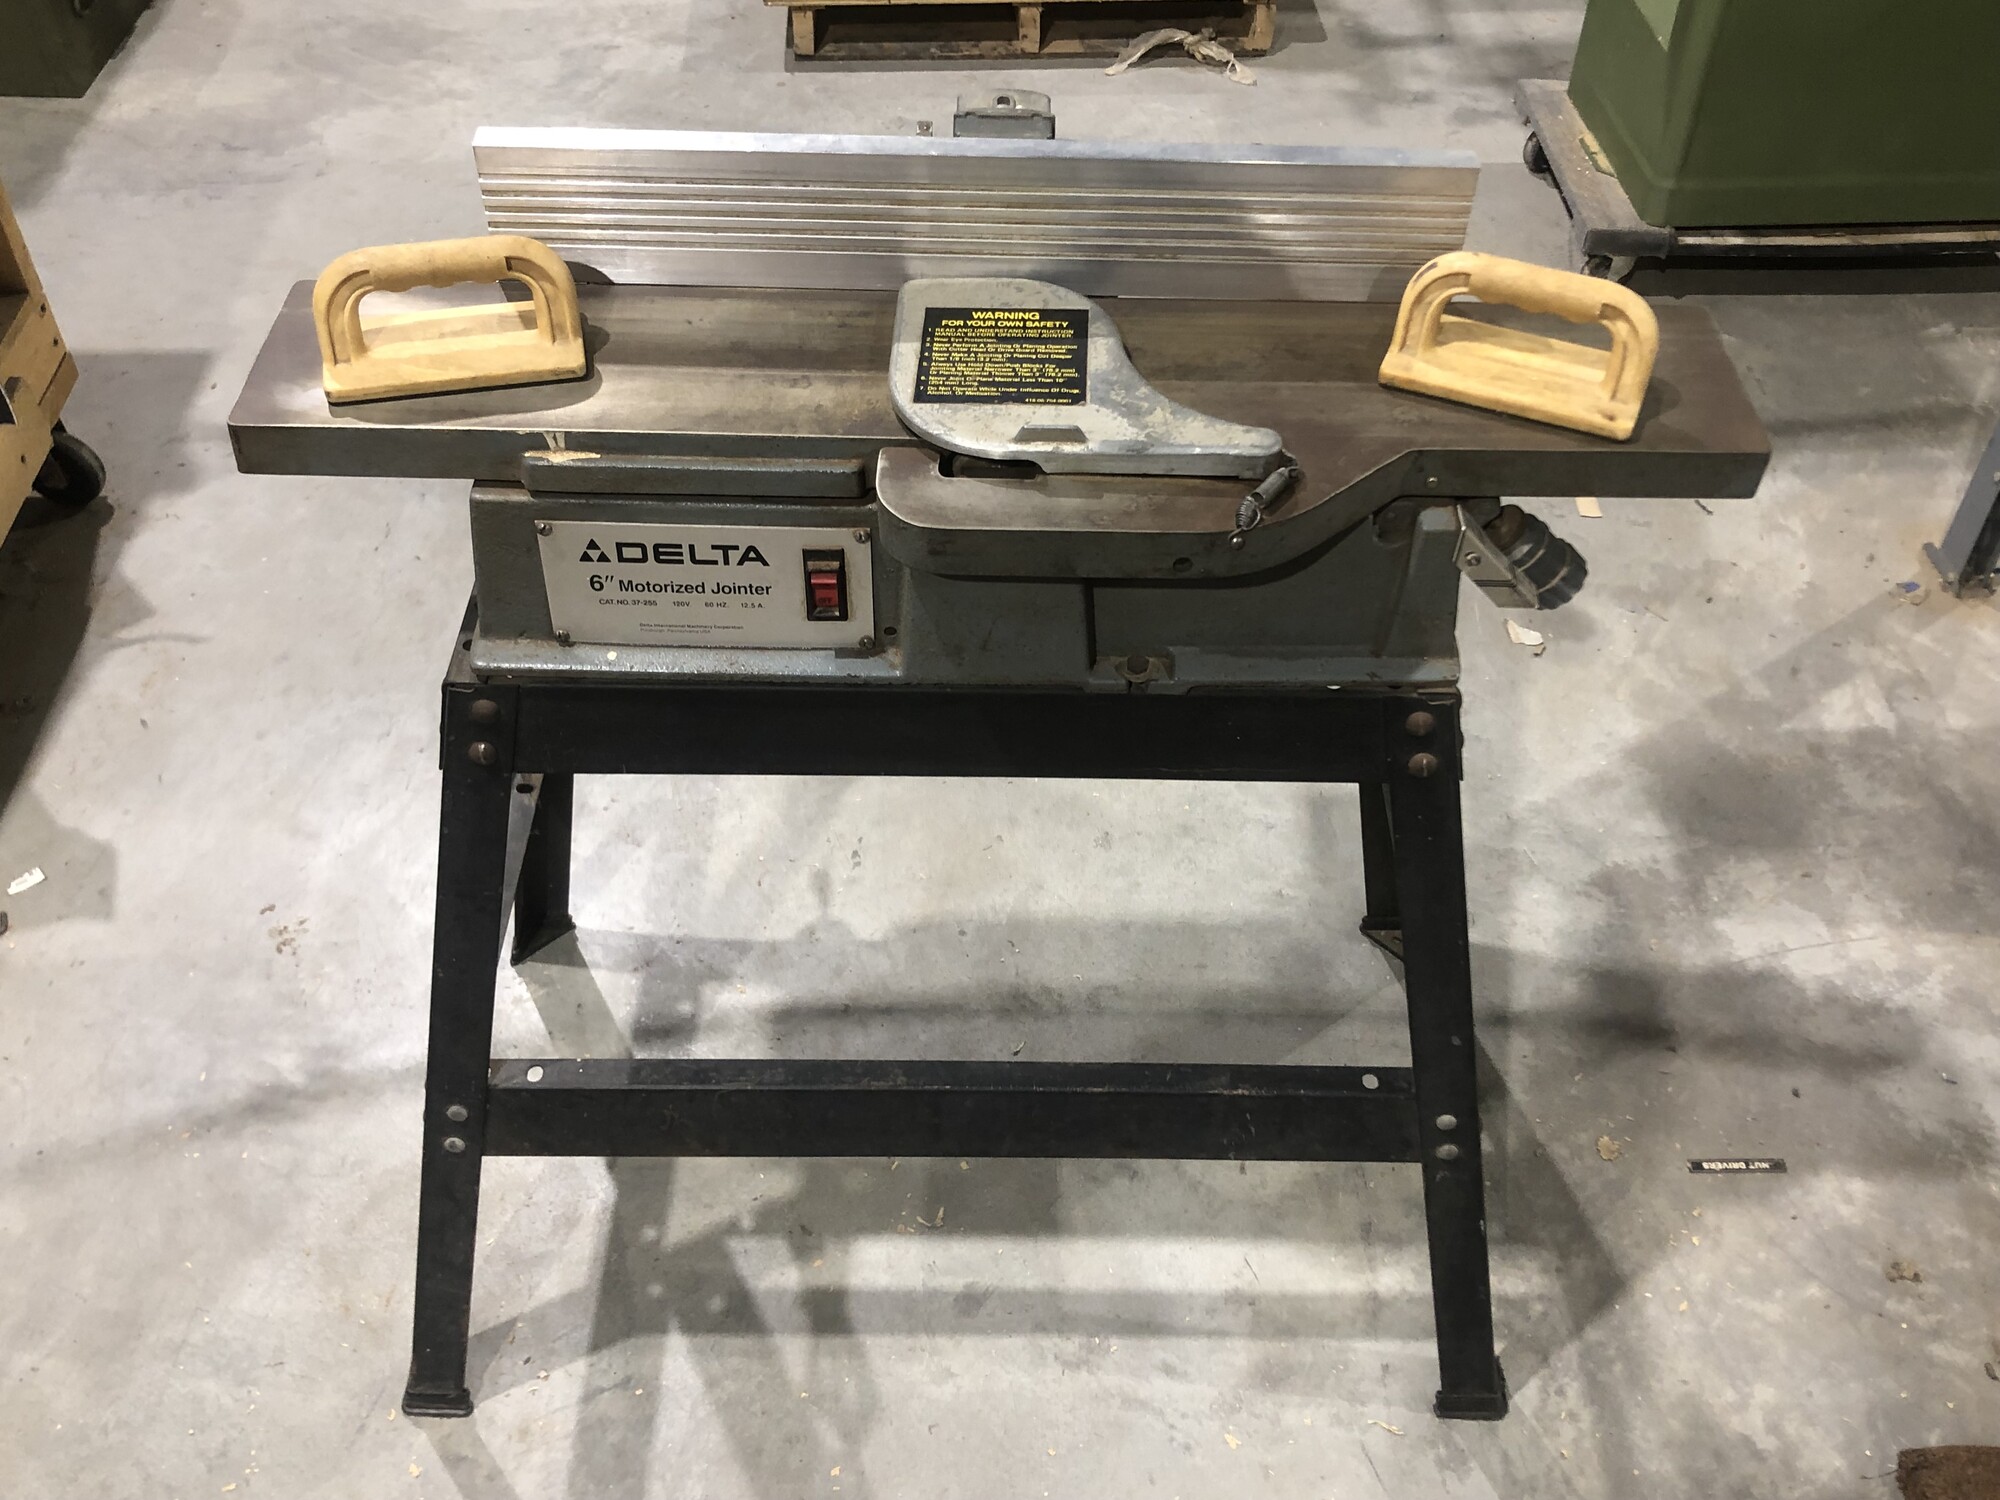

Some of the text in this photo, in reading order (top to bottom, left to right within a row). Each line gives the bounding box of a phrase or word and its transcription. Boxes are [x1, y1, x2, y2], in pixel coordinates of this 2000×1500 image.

[972, 311, 1040, 320] WARNING
[941, 319, 964, 327] FOR
[997, 320, 1024, 328] OWN
[615, 541, 770, 567] DELTA
[589, 574, 772, 596] 6" Motorized Jointer
[631, 599, 658, 607] 37-255
[1701, 1161, 1770, 1170] NUT DRIVERS
